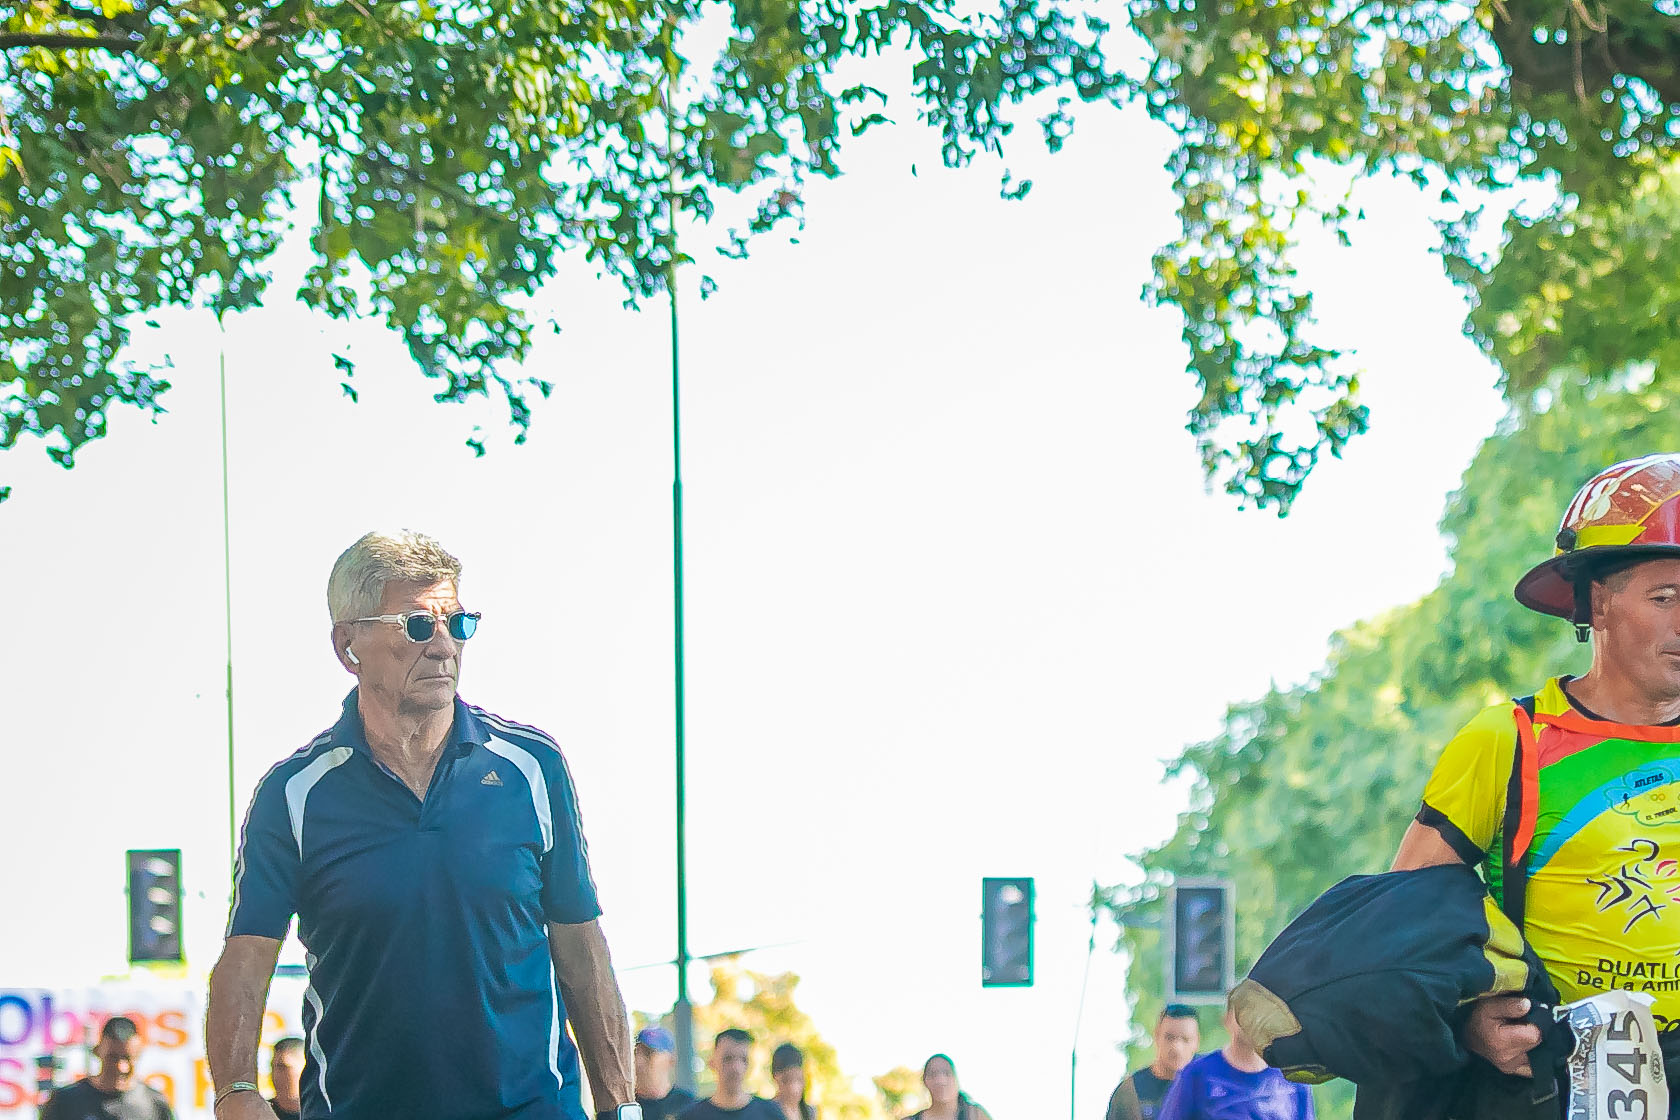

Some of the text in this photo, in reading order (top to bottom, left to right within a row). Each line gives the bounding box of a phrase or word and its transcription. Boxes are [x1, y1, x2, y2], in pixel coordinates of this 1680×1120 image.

[1634, 773, 1665, 789] ATLETAS
[1577, 970, 1604, 989] De
[1610, 975, 1634, 992] La
